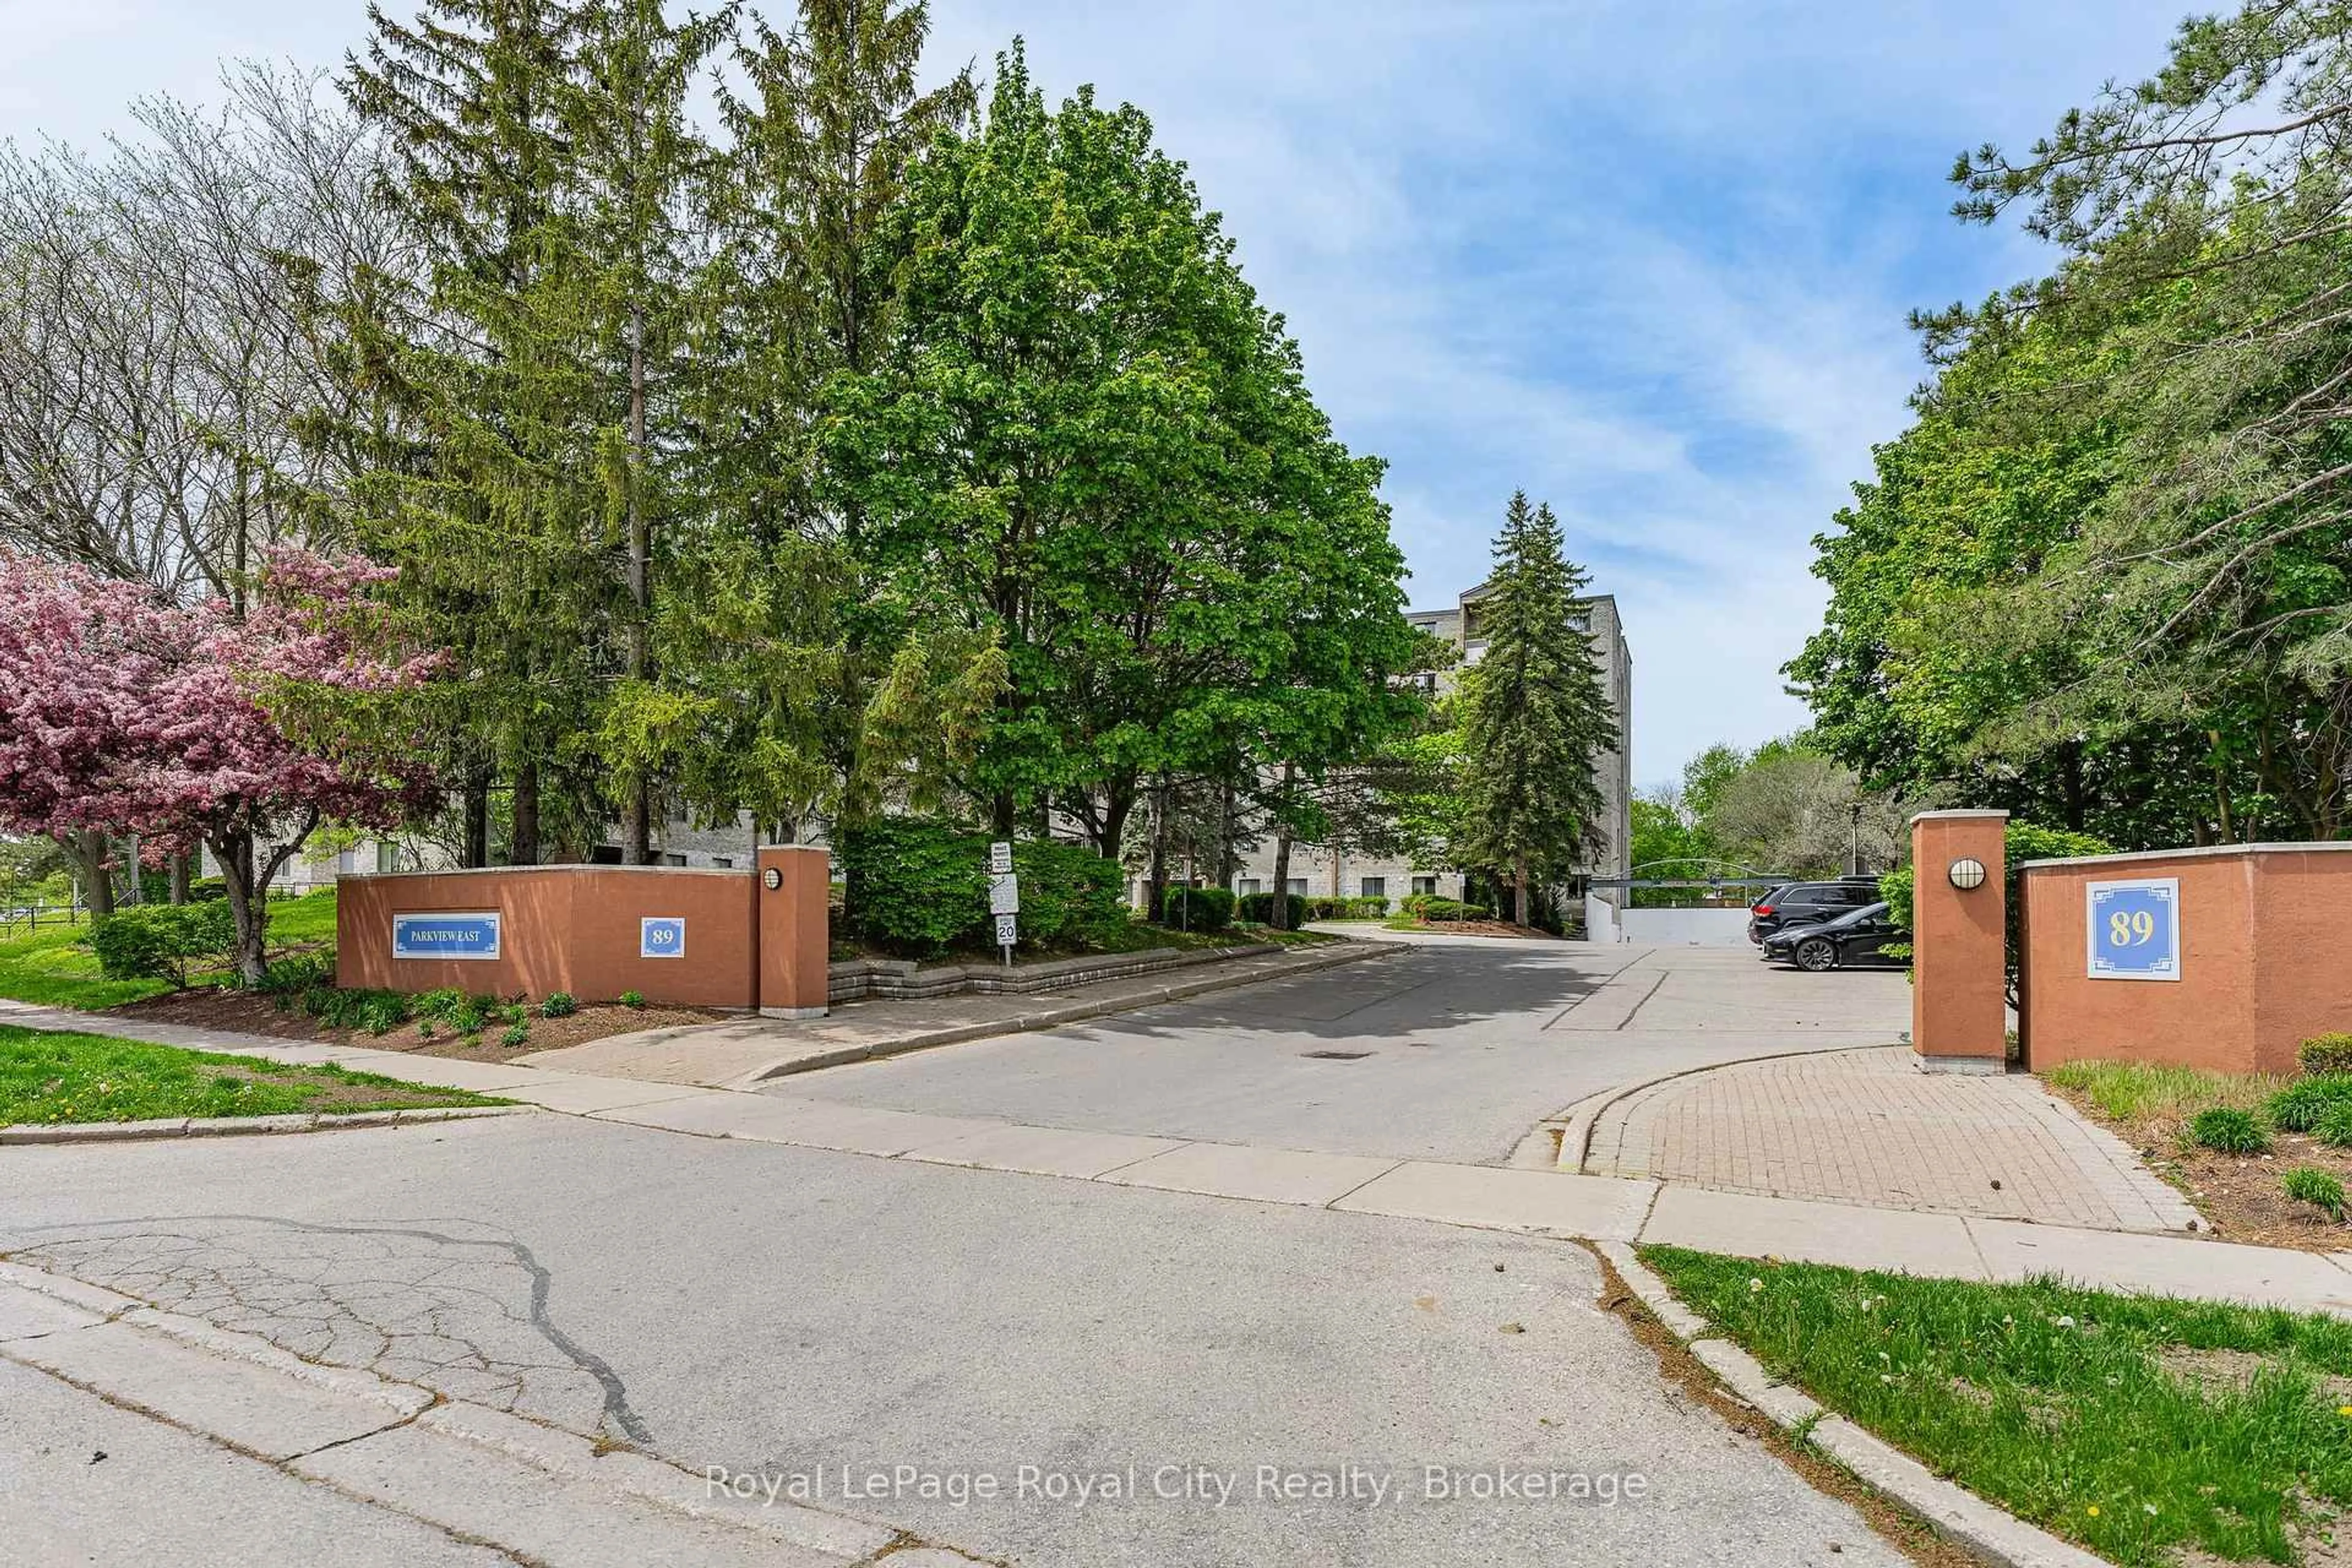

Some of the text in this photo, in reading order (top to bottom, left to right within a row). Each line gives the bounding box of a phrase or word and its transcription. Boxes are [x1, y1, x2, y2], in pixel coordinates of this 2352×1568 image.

[999, 926, 1014, 937] 20
[2110, 911, 2153, 946] 89
[411, 930, 481, 942] PARKVIEW EAST
[653, 929, 673, 944] 89
